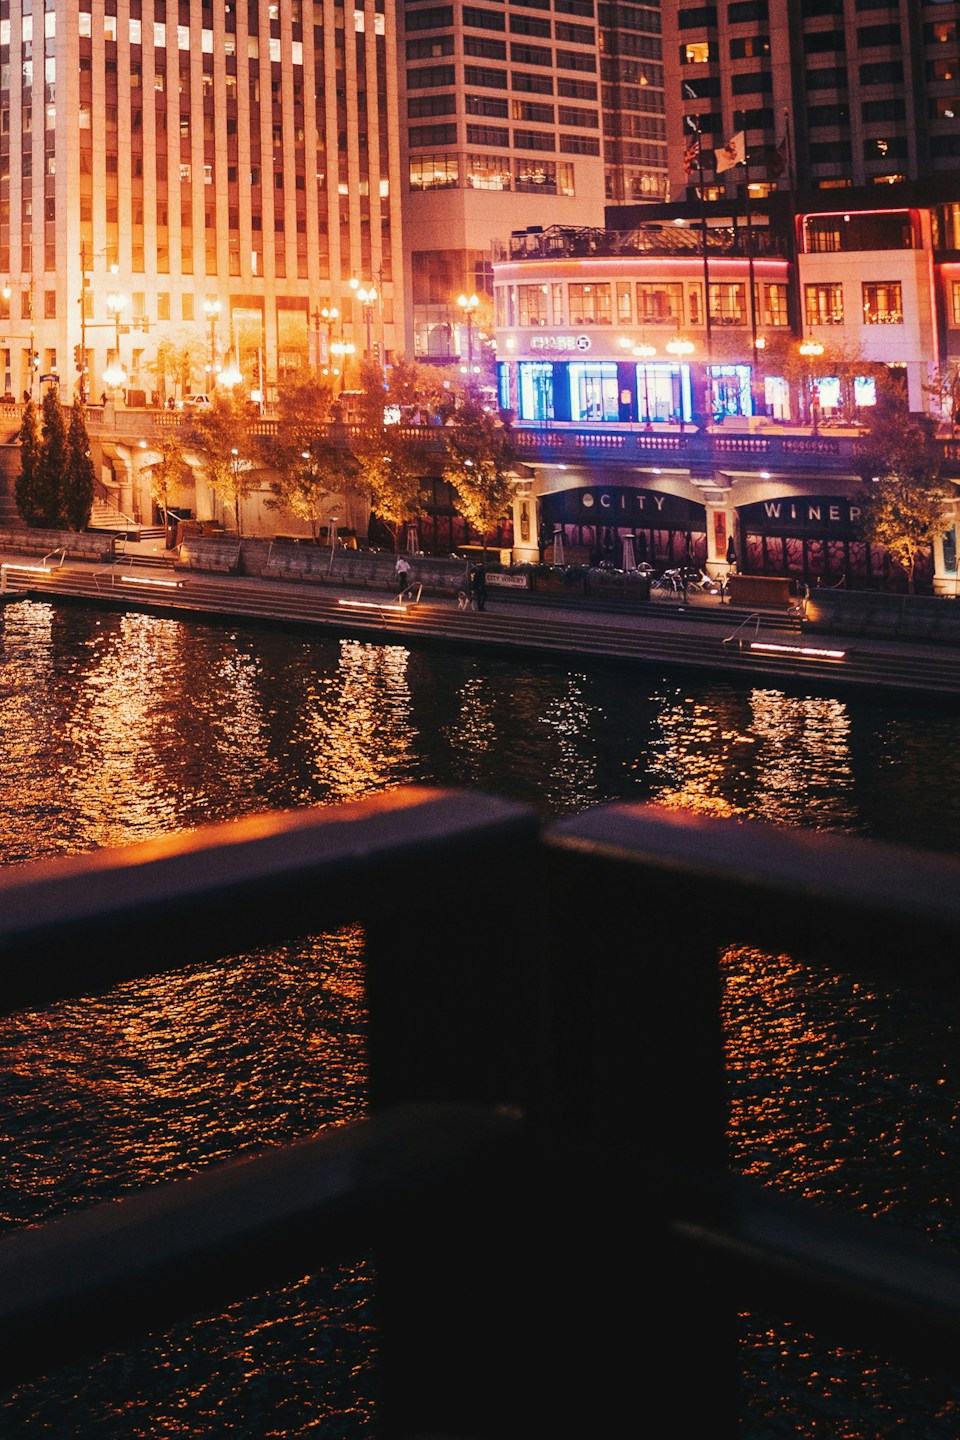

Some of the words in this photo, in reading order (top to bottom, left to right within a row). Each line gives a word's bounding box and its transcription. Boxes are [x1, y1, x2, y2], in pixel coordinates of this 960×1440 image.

[531, 336, 576, 350] CHASE
[600, 494, 665, 511] CITY
[764, 502, 861, 521] WINER
